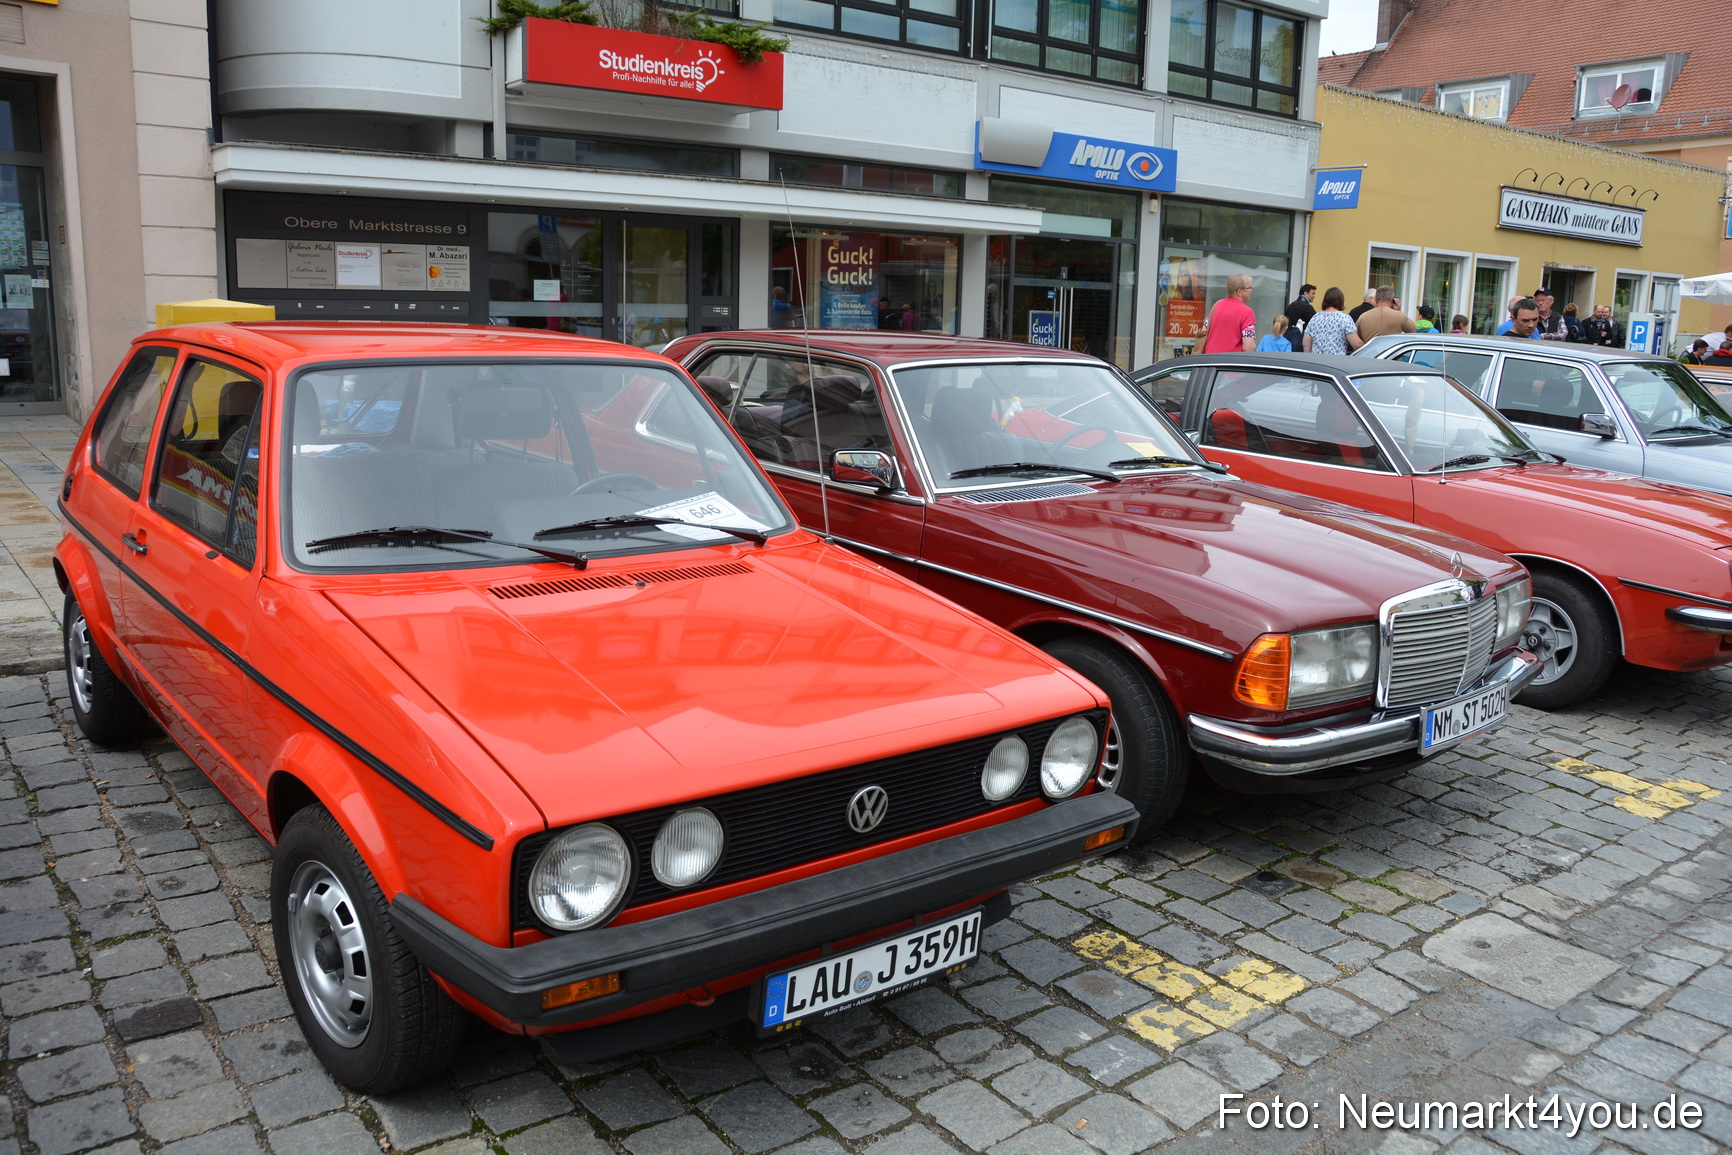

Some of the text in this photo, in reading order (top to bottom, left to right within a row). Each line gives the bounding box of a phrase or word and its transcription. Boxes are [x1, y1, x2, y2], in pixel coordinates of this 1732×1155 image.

[599, 49, 704, 80] Studienkreis
[612, 71, 694, 89] Profi-Nachhilfe für alle!
[1095, 169, 1120, 180] OPTIK
[284, 216, 466, 235] Obere Marktstrasse 9
[1506, 198, 1640, 236] GASTHAUS mittlere GANS
[338, 250, 368, 258] Studienkreis
[439, 252, 468, 260] Abazari
[828, 246, 873, 266] Guck!
[827, 266, 873, 286] Guck!
[1634, 325, 1645, 340] P
[688, 504, 721, 519] 646
[1433, 686, 1506, 740] NM ST 502H
[786, 916, 979, 1014] LAU J 359H
[768, 1005, 777, 1018] D
[824, 1008, 838, 1018] Auto
[856, 995, 877, 1006] Altdorf
